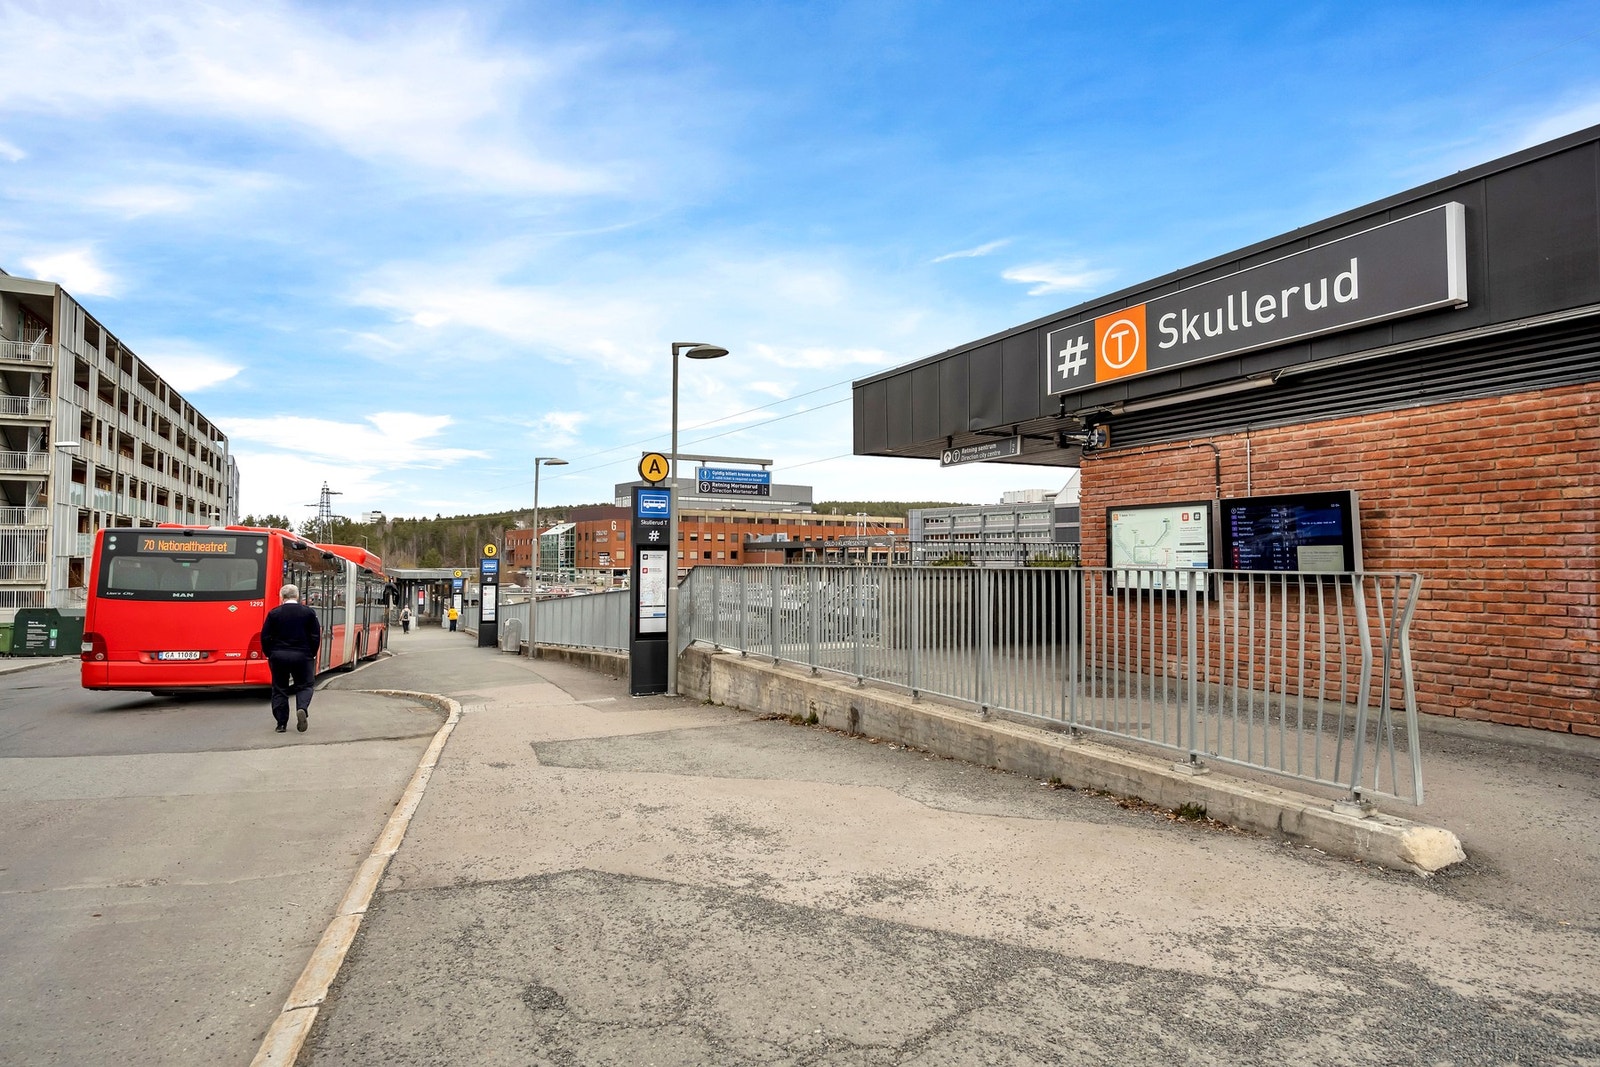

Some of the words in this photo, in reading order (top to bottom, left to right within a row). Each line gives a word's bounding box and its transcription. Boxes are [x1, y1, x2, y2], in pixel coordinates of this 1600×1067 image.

[1158, 257, 1359, 350] Skullerud
[961, 446, 977, 454] Retning
[978, 443, 997, 452] sentrum
[961, 453, 978, 461] Direction
[648, 458, 662, 474] A
[611, 520, 616, 531] G
[144, 540, 154, 550] 70
[158, 540, 228, 552] Nationaltheatret
